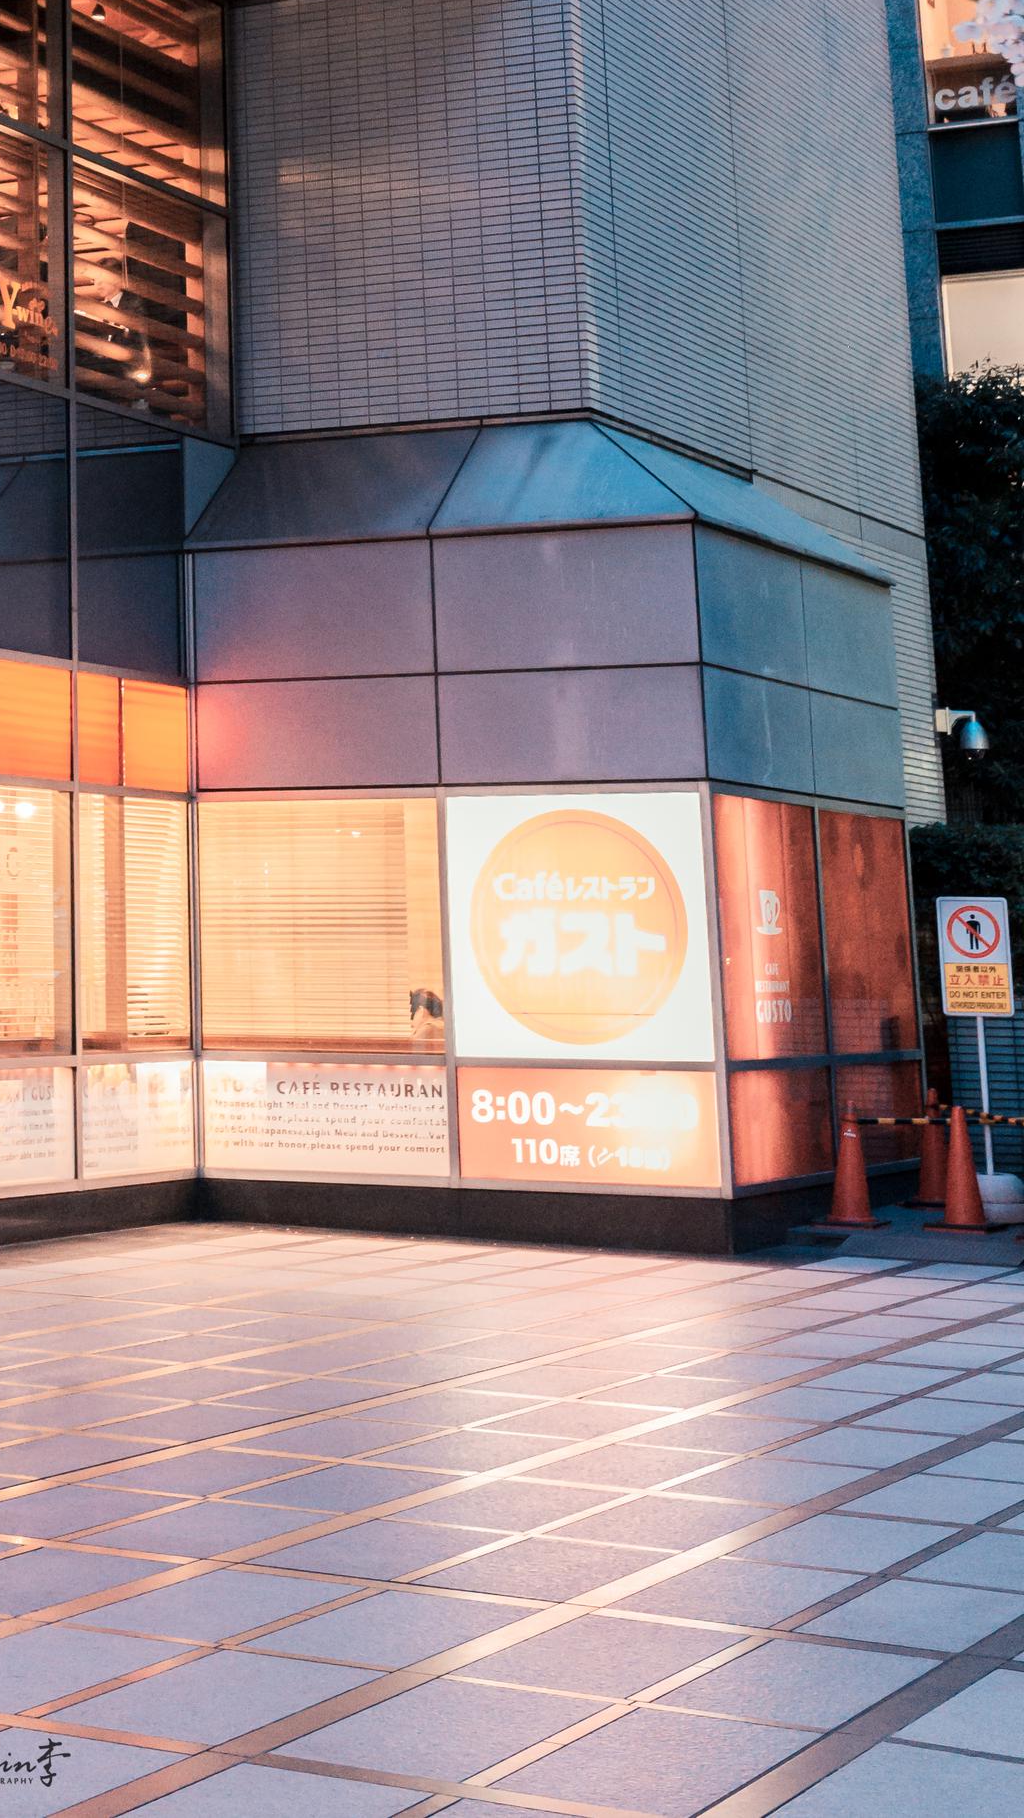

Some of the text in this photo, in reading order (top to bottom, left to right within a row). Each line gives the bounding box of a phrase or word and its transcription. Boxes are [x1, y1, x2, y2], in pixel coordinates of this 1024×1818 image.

[935, 75, 1017, 111] café
[499, 906, 667, 978] ガスト
[949, 974, 1005, 987] 立入禁止
[962, 991, 979, 999] NOT
[980, 991, 1007, 999] ENTER
[755, 998, 793, 1024] GUSTO
[345, 1143, 374, 1154] spend
[378, 1145, 401, 1154] your
